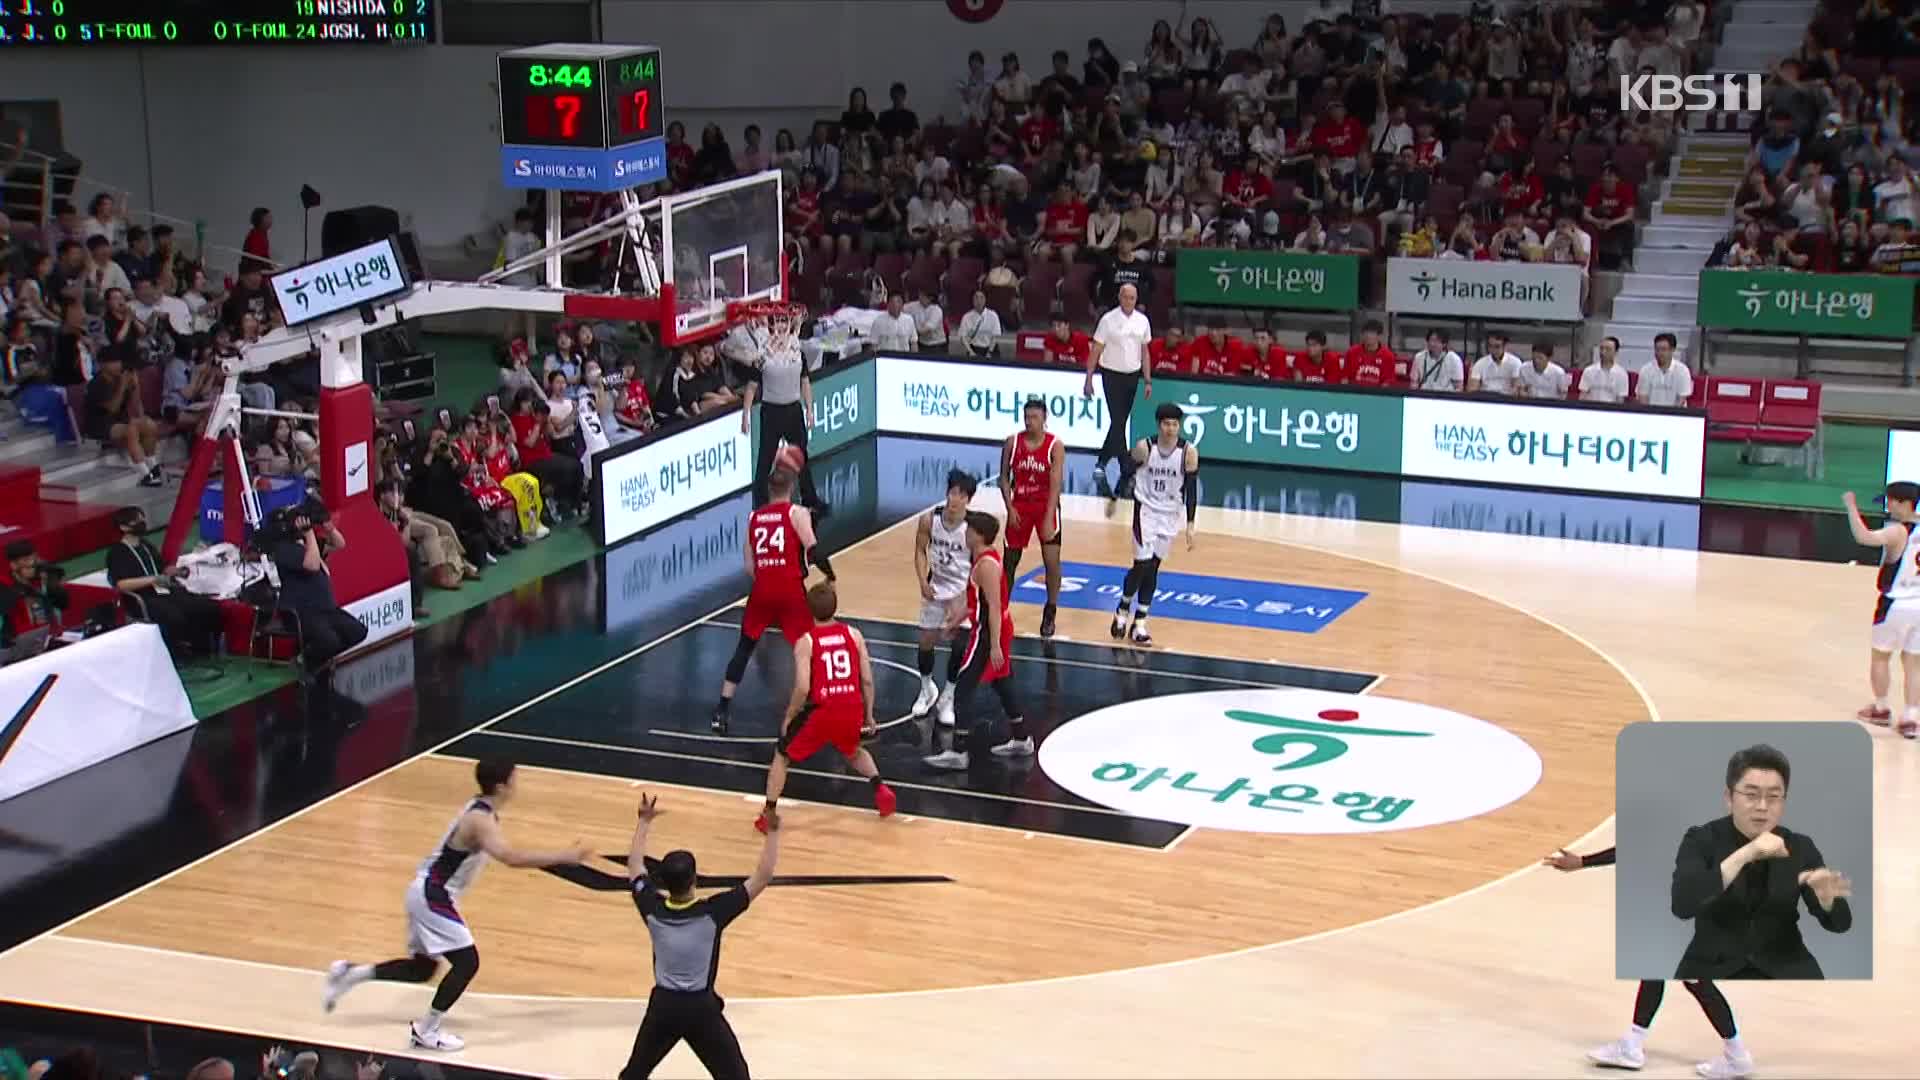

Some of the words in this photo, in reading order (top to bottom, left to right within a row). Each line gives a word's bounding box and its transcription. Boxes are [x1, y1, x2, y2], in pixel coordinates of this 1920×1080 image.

[297, 1, 313, 15] 19
[317, 0, 386, 15] NISHIDA
[95, 24, 156, 40] T-FOUL
[233, 24, 289, 39] T-FOUL
[296, 25, 315, 39] 24
[529, 64, 592, 88] 8:44
[554, 95, 581, 137] 7
[634, 89, 648, 129] 7
[315, 254, 391, 296] 하나은행
[1242, 267, 1325, 294] 하나은행
[1441, 277, 1497, 301] Hana
[1501, 280, 1555, 302] Bank
[1775, 289, 1873, 319] 하나은행
[904, 382, 949, 401] HANA
[804, 384, 858, 440] 나은행
[921, 400, 960, 418] EASY
[967, 387, 1102, 429] 하나이지
[1224, 404, 1359, 452] 하나은행
[1434, 424, 1486, 443] HANA
[1453, 445, 1499, 462] EASY
[1508, 429, 1669, 475] 하나더이지
[660, 436, 736, 497] 하나더이지
[620, 471, 649, 496] HANA
[631, 488, 656, 512] EASY
[754, 526, 785, 554] 24
[821, 649, 851, 681] 19
[1091, 761, 1416, 824] 하나은행
